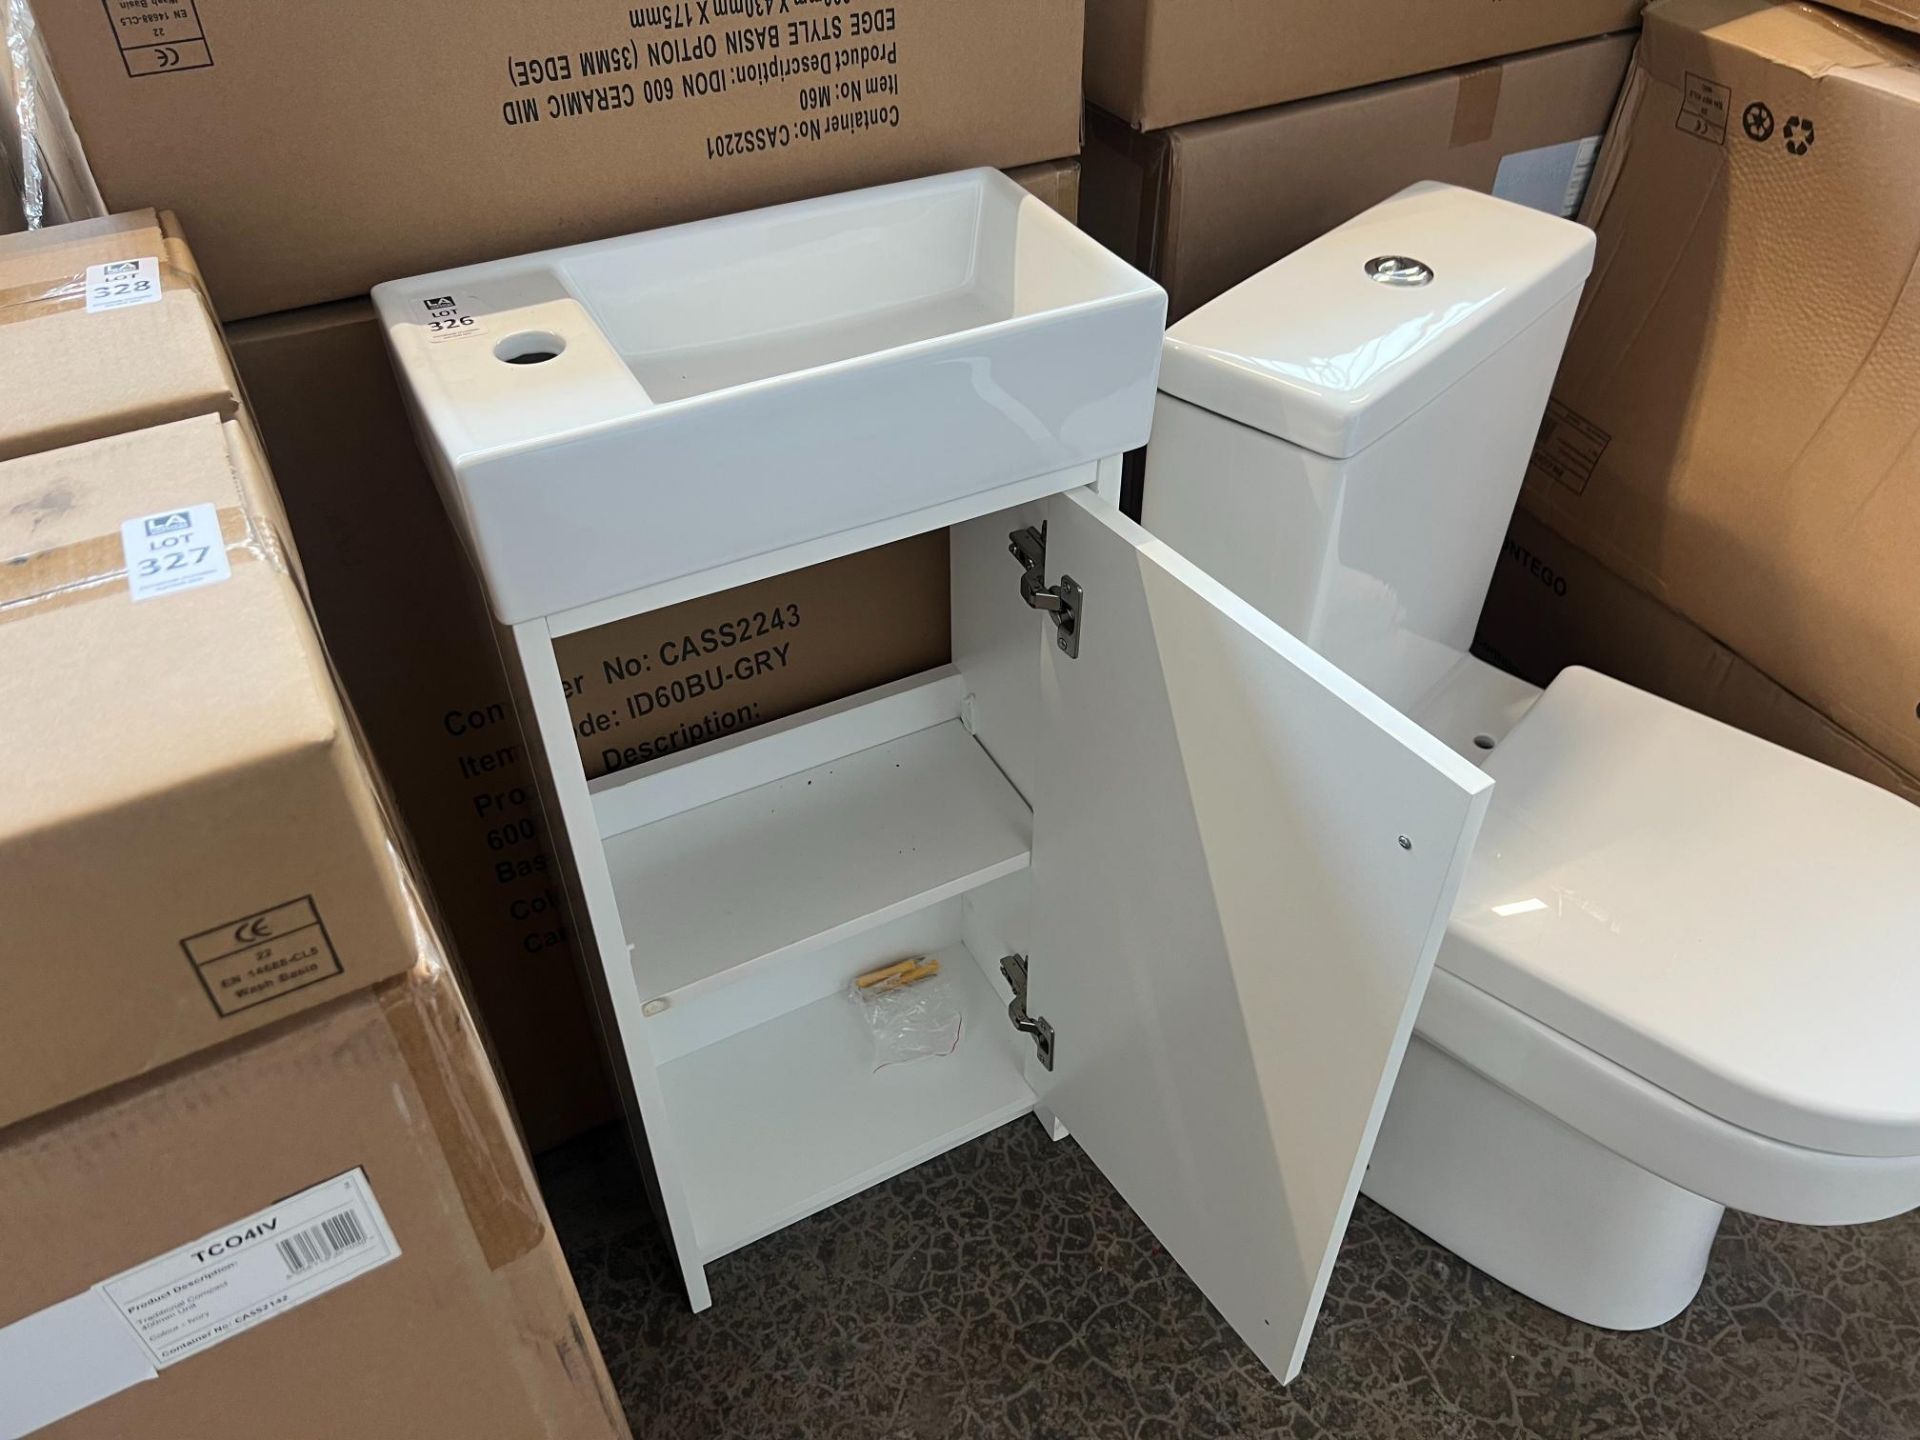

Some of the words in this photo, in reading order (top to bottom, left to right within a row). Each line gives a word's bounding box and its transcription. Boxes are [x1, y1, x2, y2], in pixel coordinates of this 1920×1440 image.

[173, 9, 188, 19] EN
[628, 2, 693, 30] 175mm
[696, 0, 710, 25] X
[712, 0, 773, 18] 430mm
[849, 7, 896, 36] EDGE
[152, 27, 165, 37] 22
[725, 24, 780, 55] BASIN
[787, 15, 842, 46] STYLE
[579, 39, 638, 77] (35MM
[647, 34, 717, 67] OPTION
[834, 41, 897, 72] Product
[507, 55, 572, 87] EDGE)
[681, 69, 727, 98] IDON
[730, 52, 832, 86] Description:
[643, 77, 674, 104] 600
[799, 85, 831, 111] M60
[835, 79, 862, 102] No:
[865, 74, 898, 96] Item
[502, 97, 540, 126] MID
[547, 83, 634, 119] CERAMIC
[794, 118, 821, 141] No:
[824, 105, 900, 134] Container
[706, 124, 790, 160] CASS2201
[93, 280, 151, 299] 328
[105, 272, 139, 283] LOT
[427, 315, 475, 332] 326
[431, 308, 458, 318] LOT
[149, 532, 195, 552] LOT
[137, 545, 211, 577] 327
[602, 653, 652, 684] No:
[659, 604, 801, 666] CASS2243
[574, 710, 620, 739] de:
[626, 641, 791, 719] ID60BU-GRY
[602, 701, 761, 772] Description:
[487, 818, 536, 851] 600
[495, 854, 547, 884] Bas
[256, 948, 272, 961] 22
[220, 975, 242, 989] EN
[235, 979, 274, 998] Wash
[278, 963, 319, 983] Basin
[127, 1290, 171, 1315] Product
[173, 1261, 239, 1294] Description:
[136, 1300, 186, 1326] Traditional
[161, 1331, 213, 1358] Container
